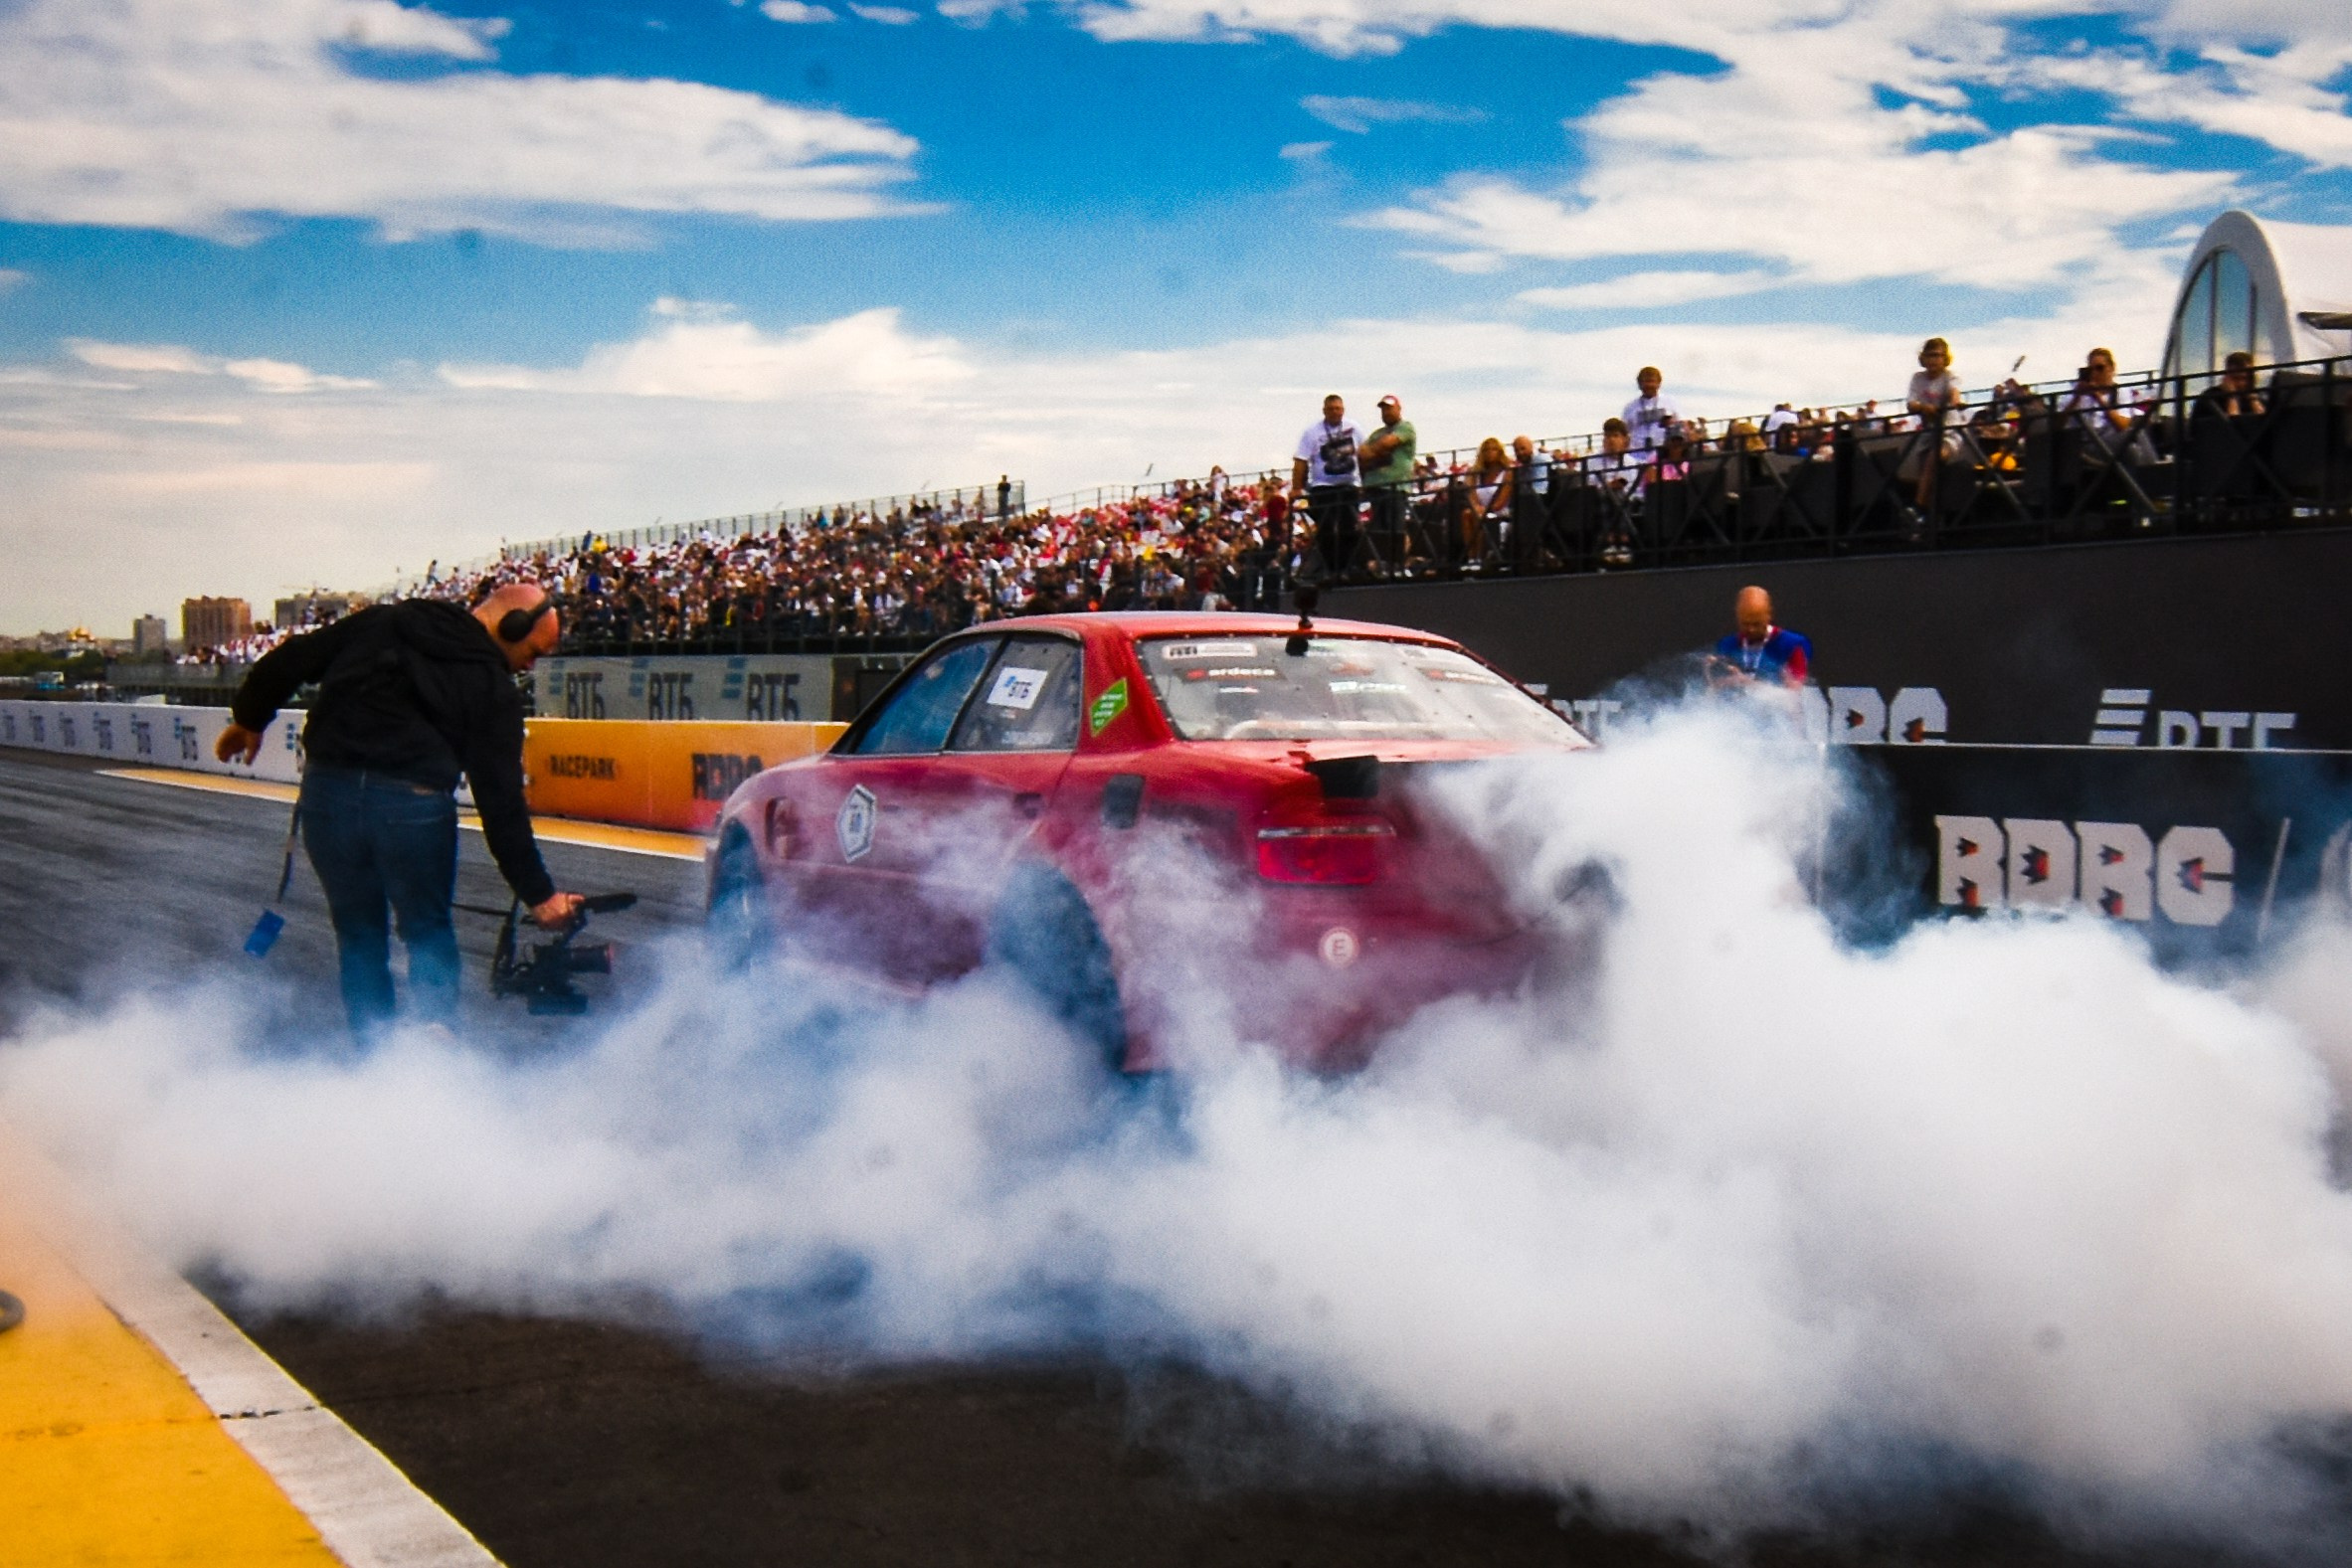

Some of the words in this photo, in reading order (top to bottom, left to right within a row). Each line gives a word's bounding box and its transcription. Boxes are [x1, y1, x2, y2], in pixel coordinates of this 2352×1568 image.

[550, 755, 616, 780] RACEPARK
[1934, 814, 2235, 926] RDRC
[1333, 939, 1347, 956] E
